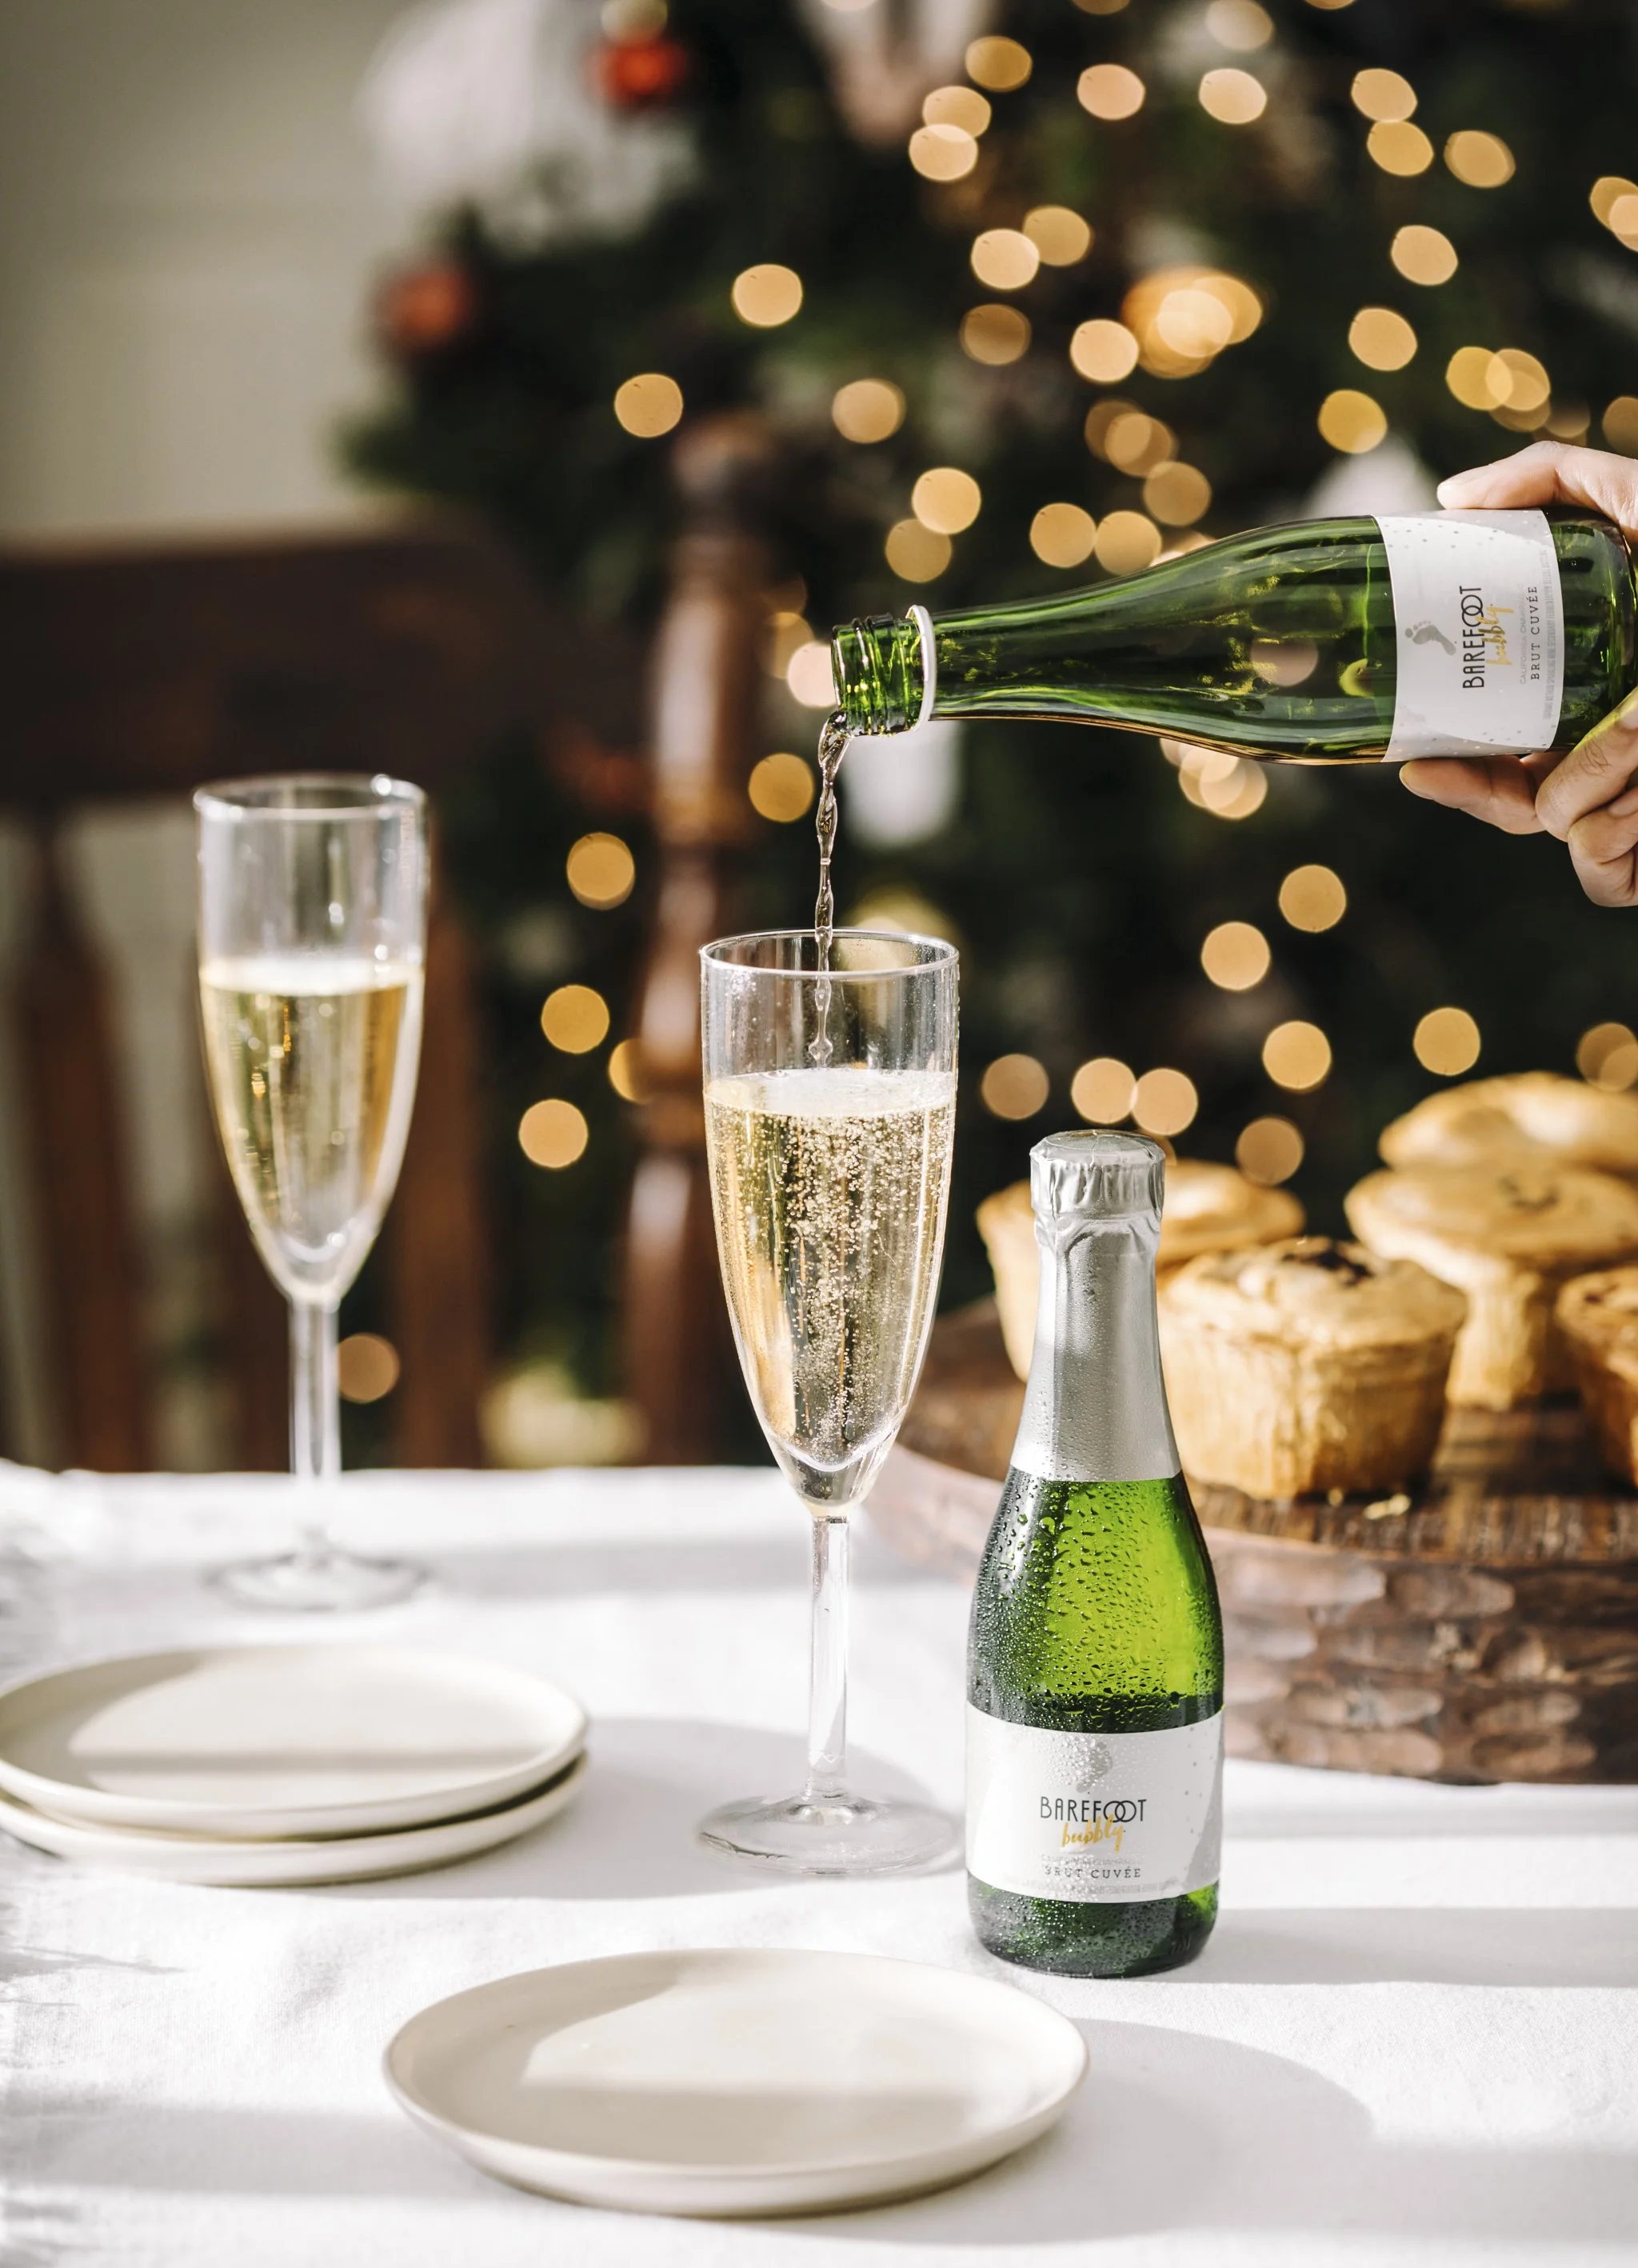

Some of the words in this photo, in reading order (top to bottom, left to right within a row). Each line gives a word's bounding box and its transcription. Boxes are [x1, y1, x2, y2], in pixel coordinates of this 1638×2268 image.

[1526, 586, 1540, 635] CUVÉE
[1460, 586, 1485, 688] BAREFOOT
[1476, 606, 1514, 666] bubbly
[1531, 642, 1540, 680] BRUT
[1040, 1796, 1147, 1822] BAREFOOT
[1061, 1814, 1124, 1853] bubbly
[1045, 1865, 1084, 1878] BRUT
[1091, 1868, 1141, 1879] CUVÉE
